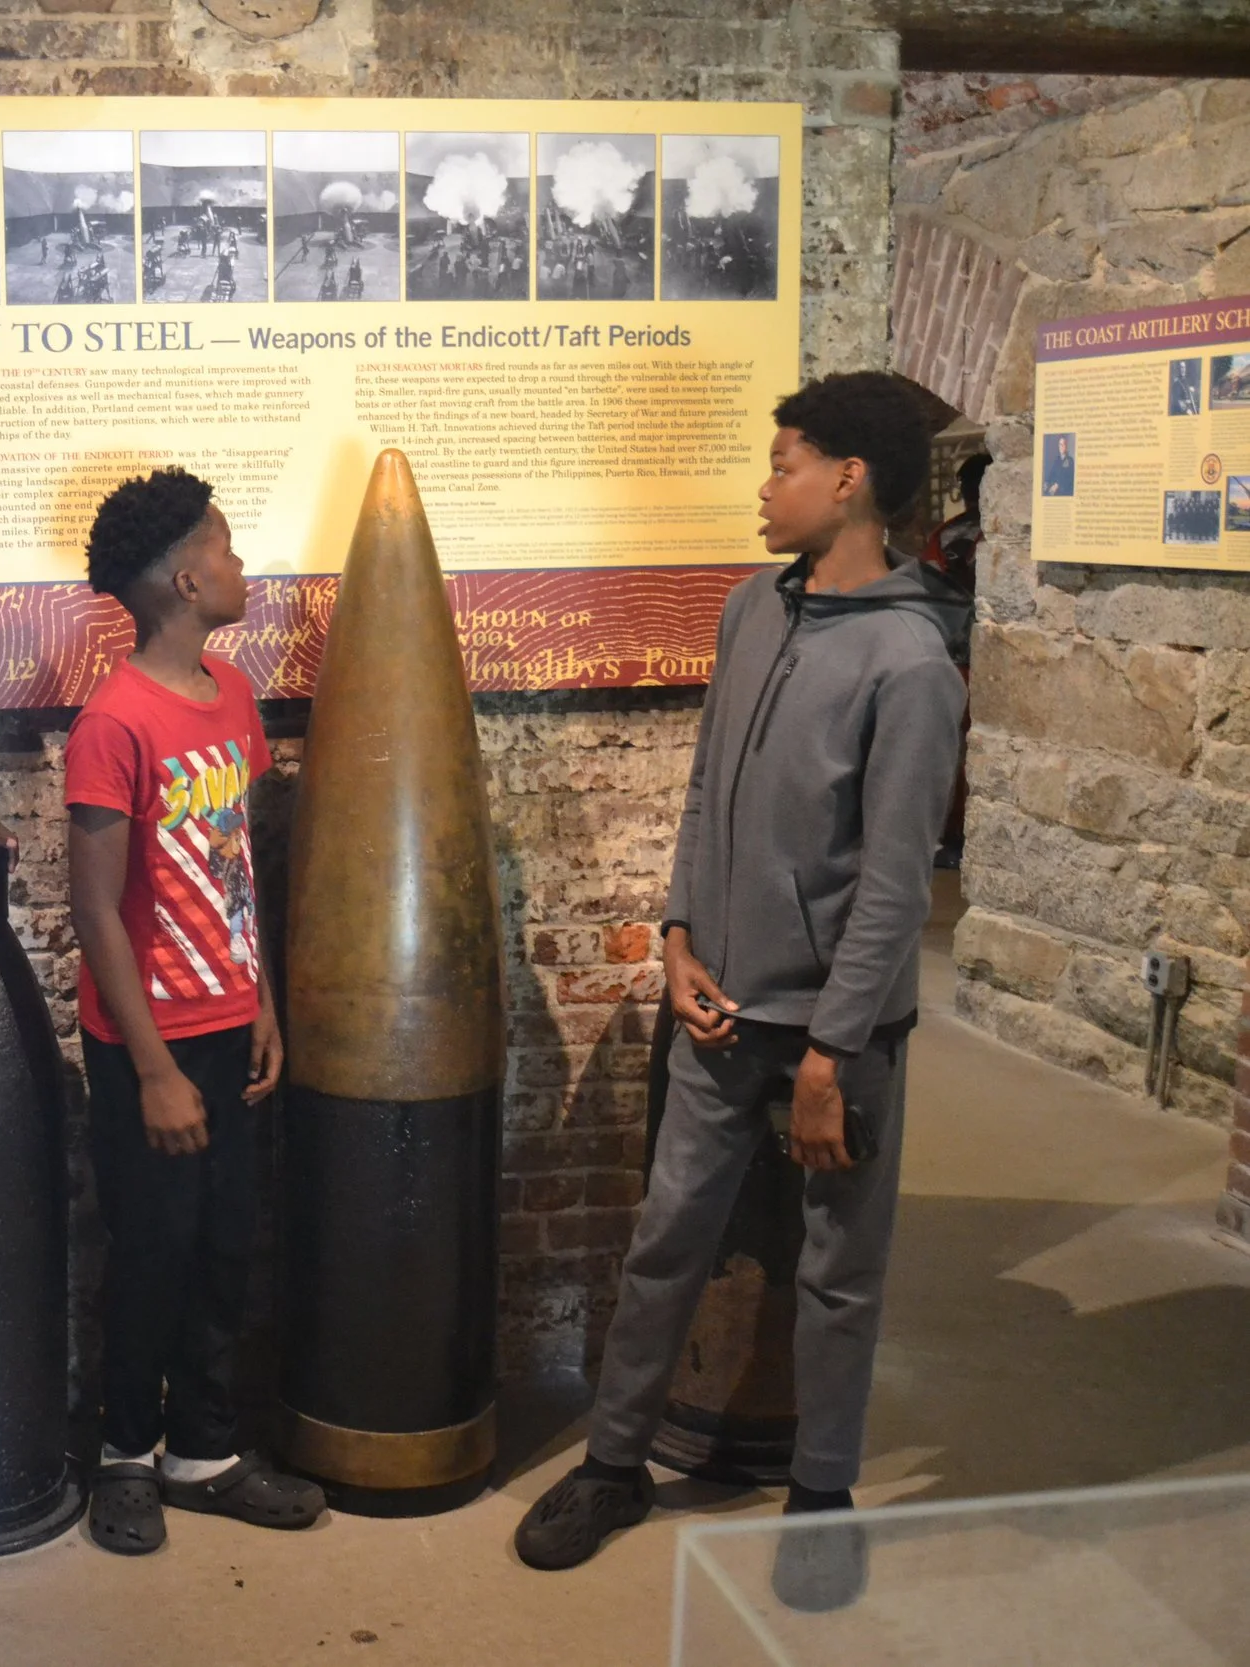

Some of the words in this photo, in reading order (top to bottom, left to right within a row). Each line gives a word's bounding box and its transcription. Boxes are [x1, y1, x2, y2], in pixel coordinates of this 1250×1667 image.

[11, 321, 73, 353] TO
[84, 320, 205, 353] STEEL
[248, 327, 356, 354] Weapons
[364, 325, 386, 348] of
[395, 325, 432, 348] the
[441, 324, 601, 348] Endicott/Taft
[609, 324, 692, 347] Periods
[1043, 330, 1072, 350] THE
[1076, 323, 1125, 346] COAST
[1127, 312, 1213, 342] ARTILLERY
[0, 368, 21, 376] THE
[42, 368, 87, 376] CENTURY
[111, 369, 138, 377] many
[141, 366, 205, 377] technological
[207, 366, 276, 375] improvements
[278, 364, 298, 372] that
[0, 381, 34, 390] coastal
[84, 379, 142, 390] Gunpowder
[144, 378, 164, 387] and
[242, 377, 287, 388] improved
[290, 376, 311, 384] with
[13, 393, 64, 404] explosives
[80, 392, 101, 400] well
[117, 391, 172, 400] mechanical
[205, 390, 233, 398] which
[236, 390, 263, 398] made
[264, 391, 304, 400] gunnery
[32, 405, 43, 414] In
[92, 404, 134, 412] Portland
[196, 402, 218, 411] used
[233, 402, 260, 410] make
[262, 401, 310, 410] reinforced
[38, 417, 49, 426] of
[73, 418, 109, 427] battery
[160, 415, 189, 424] which
[217, 414, 238, 422] able
[252, 413, 301, 422] withstand
[370, 424, 406, 432] William
[498, 422, 537, 431] achieved
[538, 422, 569, 431] during
[571, 422, 586, 430] the
[586, 421, 605, 430] Taft
[606, 421, 635, 432] period
[637, 419, 668, 430] include
[670, 420, 685, 429] the
[686, 420, 723, 430] adoption
[726, 420, 735, 428] of
[22, 430, 33, 439] of
[34, 430, 51, 439] the
[402, 436, 434, 444] 14-inch
[458, 435, 501, 443] increased
[502, 436, 537, 444] spacing
[538, 434, 575, 442] between
[620, 432, 638, 441] and
[640, 432, 663, 442] major
[666, 433, 726, 444] improvements
[728, 431, 738, 440] in
[43, 452, 57, 460] OF
[62, 452, 79, 460] THE
[84, 451, 134, 459] ENDICOTT
[138, 450, 174, 458] PERIOD
[202, 449, 218, 457] the
[44, 467, 68, 475] open
[241, 460, 285, 469] skillfully
[13, 490, 53, 500] complex
[454, 611, 547, 630] LHOUN
[561, 612, 591, 628] OR
